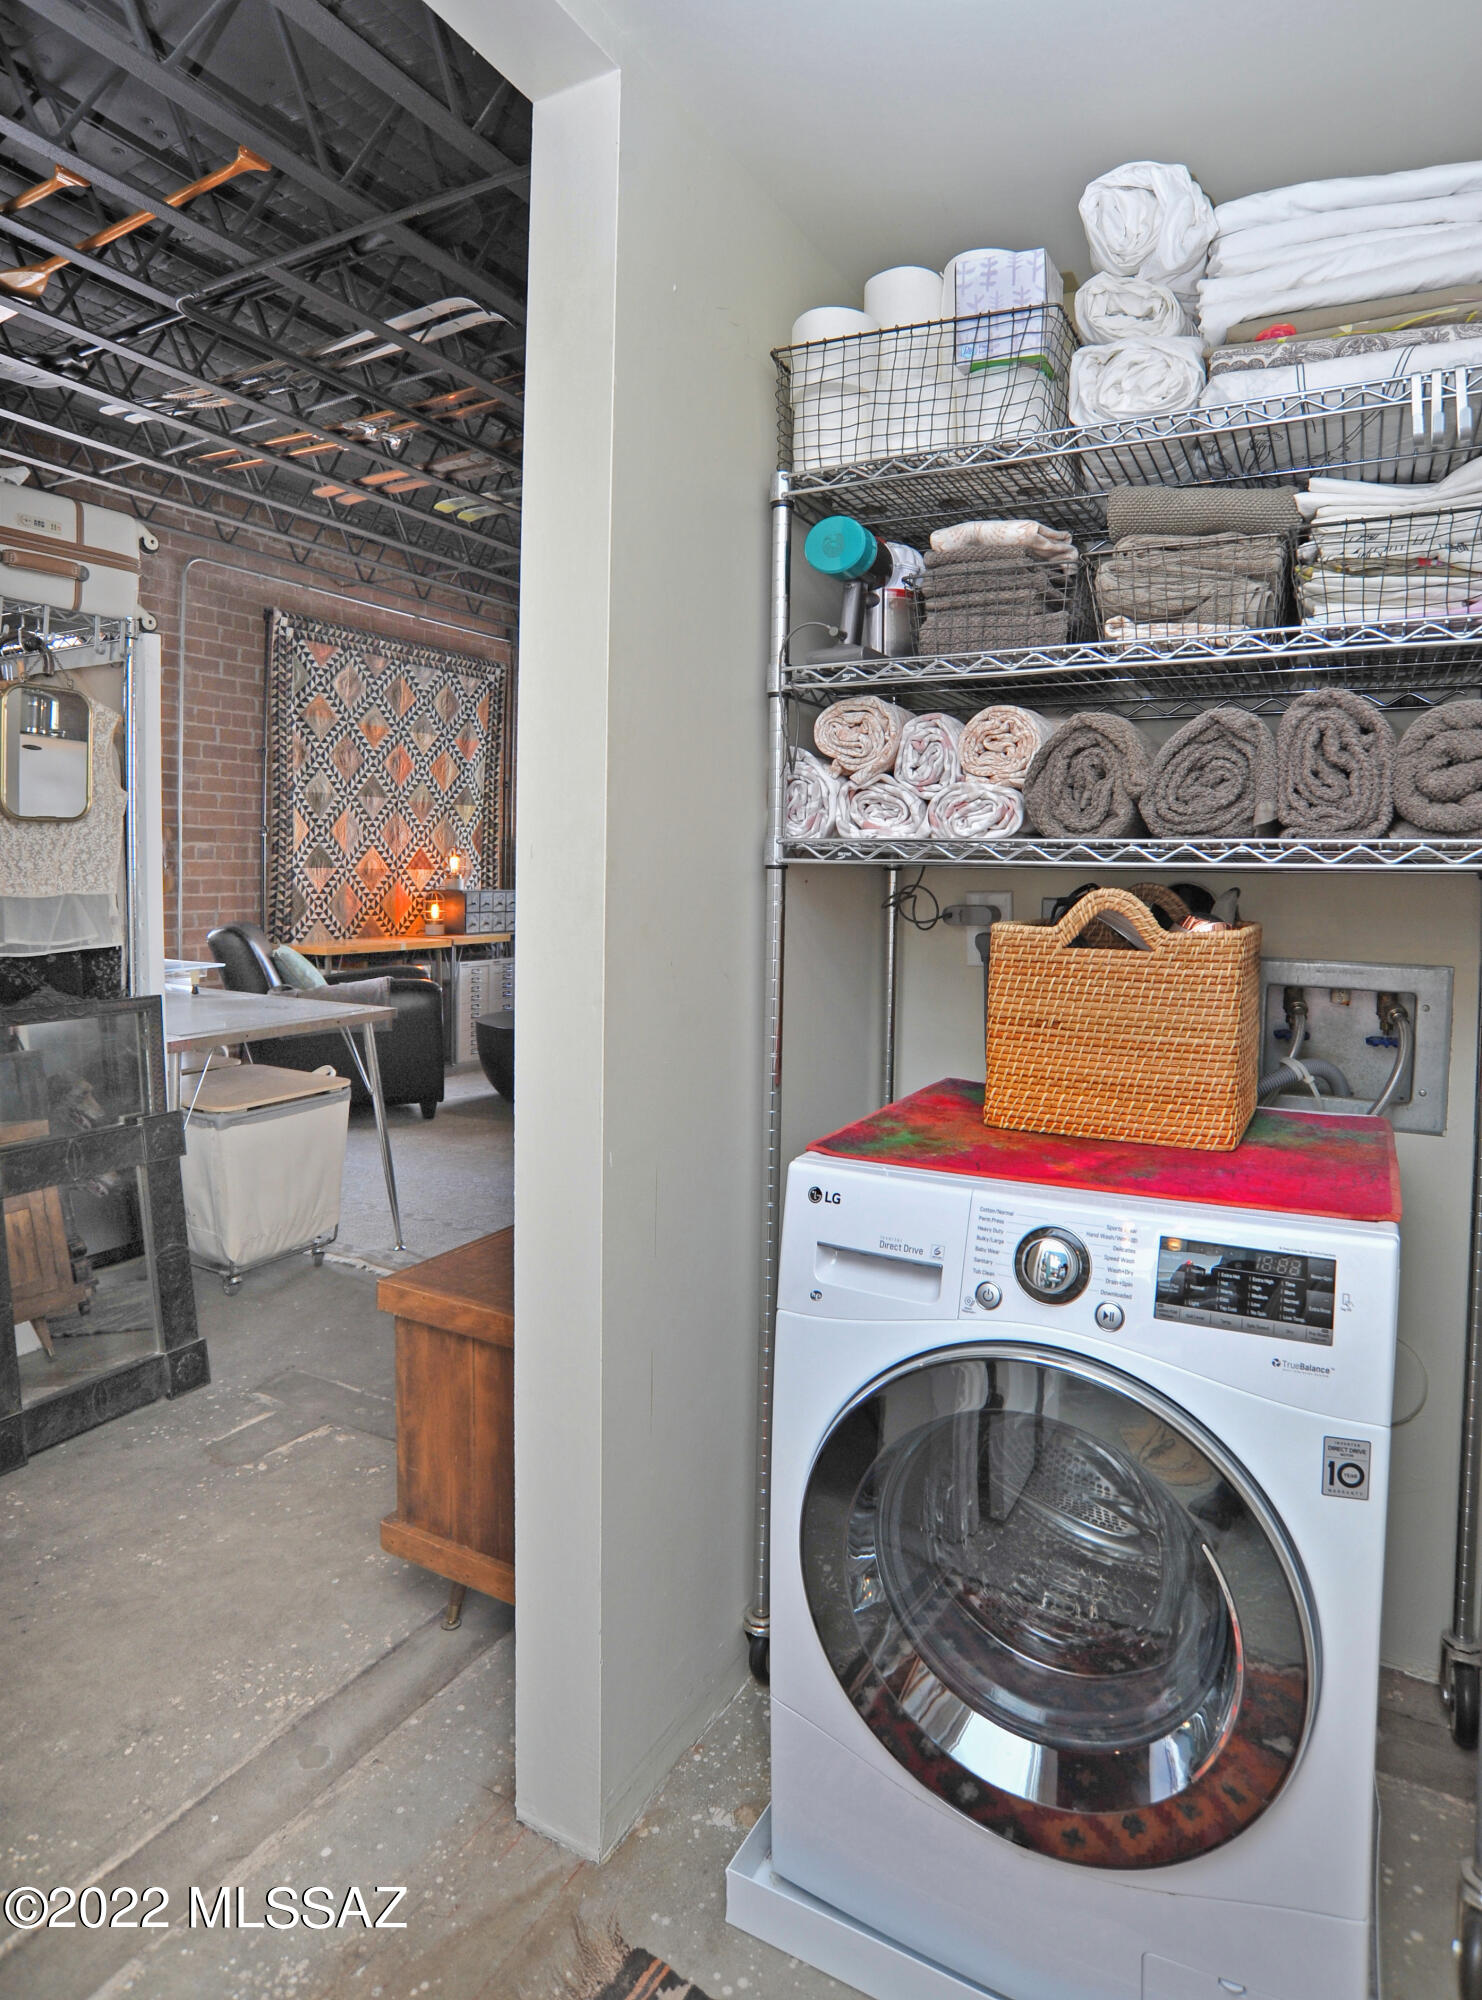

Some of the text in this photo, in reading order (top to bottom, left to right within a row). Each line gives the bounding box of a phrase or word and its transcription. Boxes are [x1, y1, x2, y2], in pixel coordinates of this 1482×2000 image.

[825, 1191, 841, 1204] LG
[879, 1240, 924, 1255] Direct Drive
[1328, 1445, 1348, 1453] DIRECT
[1328, 1460, 1365, 1489] 10
